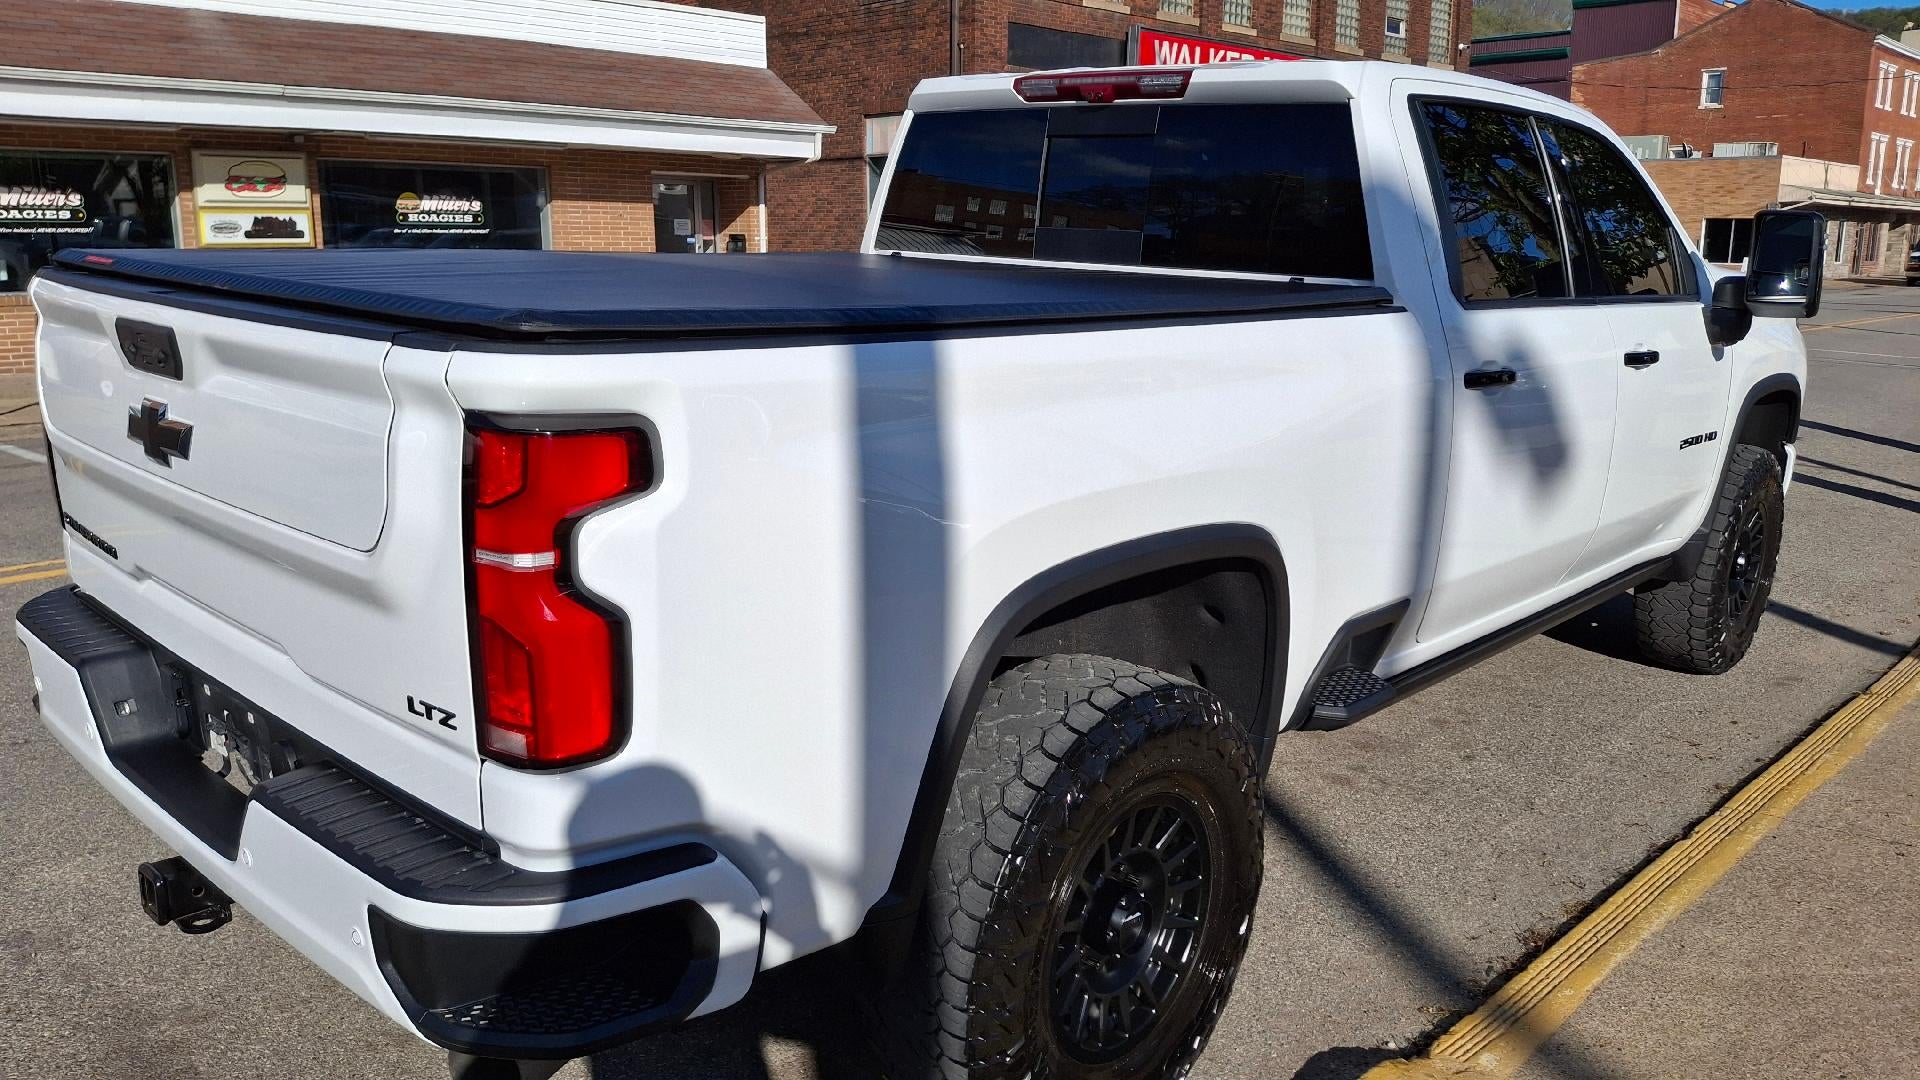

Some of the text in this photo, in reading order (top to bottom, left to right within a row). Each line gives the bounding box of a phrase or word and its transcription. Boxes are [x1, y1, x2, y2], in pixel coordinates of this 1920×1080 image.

[407, 213, 474, 223] HOAGIES
[1679, 430, 1718, 450] 2500 HD
[406, 694, 457, 731] LTZ
